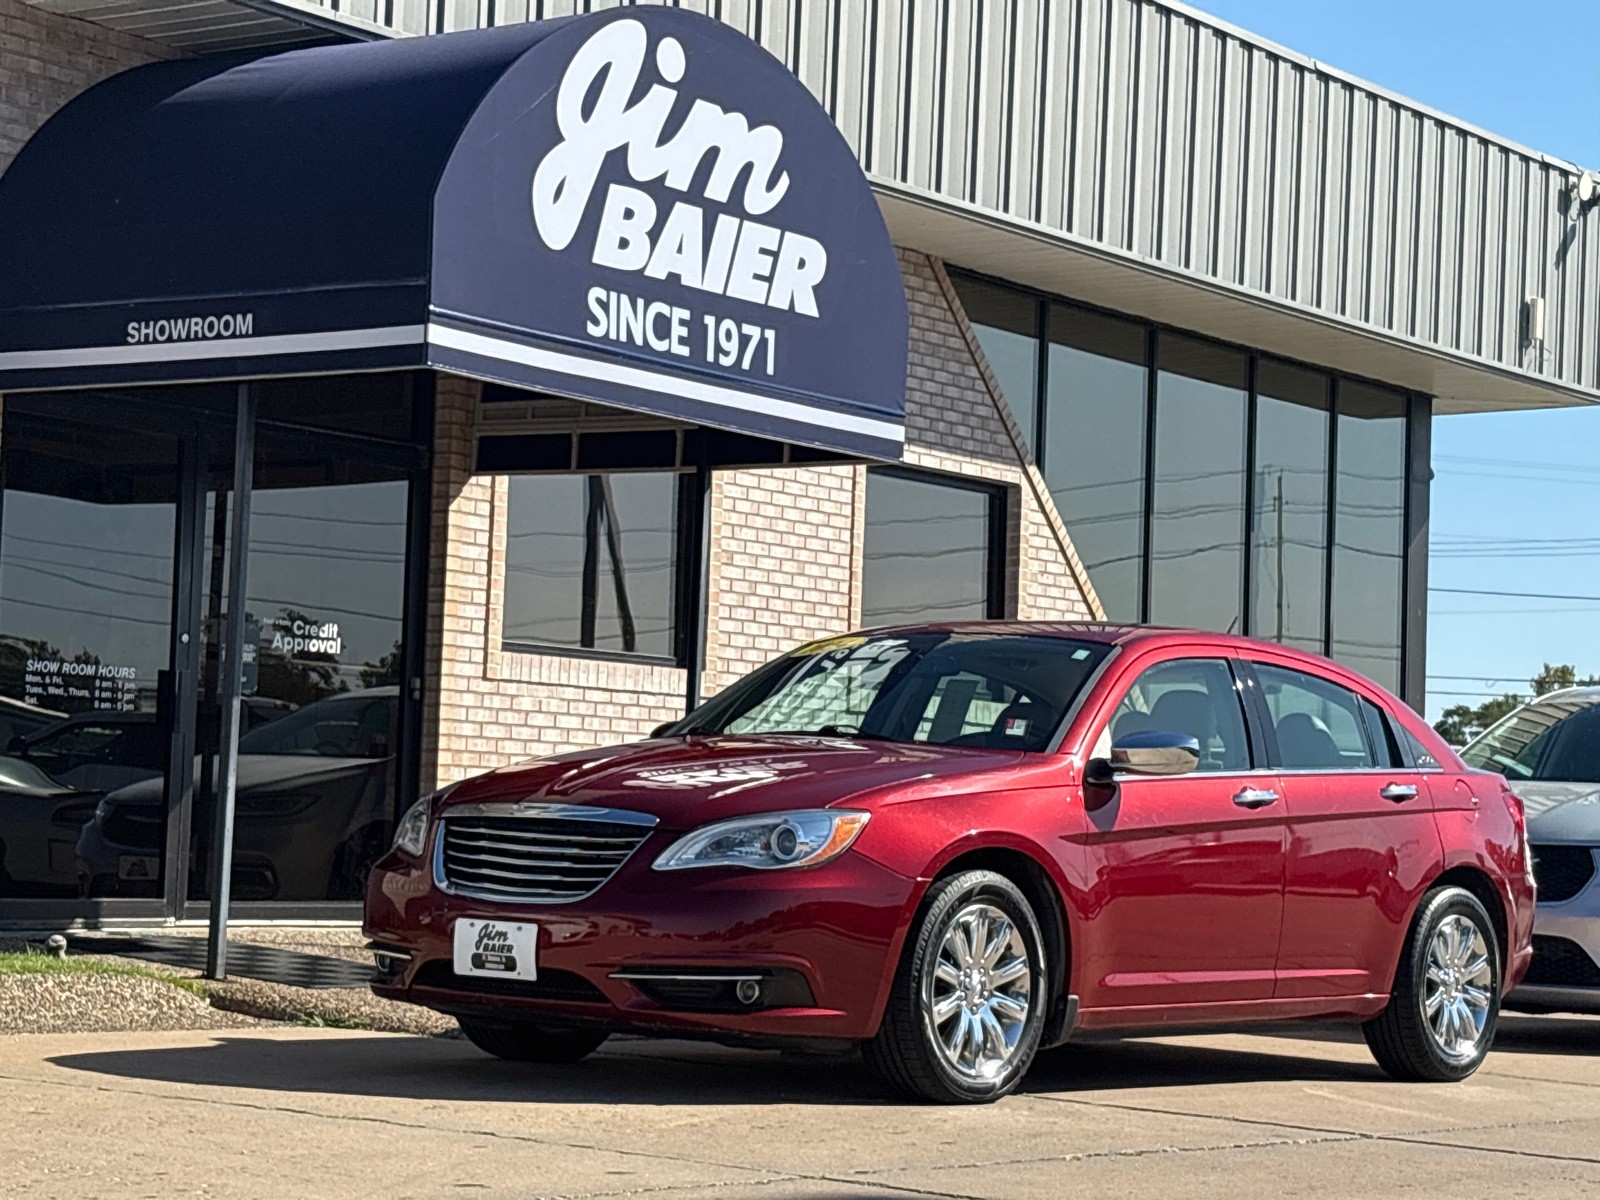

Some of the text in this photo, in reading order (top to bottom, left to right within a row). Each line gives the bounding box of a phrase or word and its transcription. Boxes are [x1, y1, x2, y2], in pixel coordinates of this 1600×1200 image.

[532, 18, 790, 251] Jim
[591, 183, 828, 318] BAIER
[126, 313, 253, 343] SHOWROOM
[586, 286, 776, 376] SINCE 1971
[293, 620, 338, 639] Credit
[271, 632, 341, 654] Approval
[26, 659, 136, 679] SHOW ROOM HOURS
[25, 674, 43, 683] Mon.
[52, 676, 64, 685] Fri.
[124, 682, 135, 690] pm
[123, 693, 135, 701] pm
[123, 703, 134, 712] pm
[475, 922, 509, 951] Jim
[482, 942, 514, 954] BAIER
